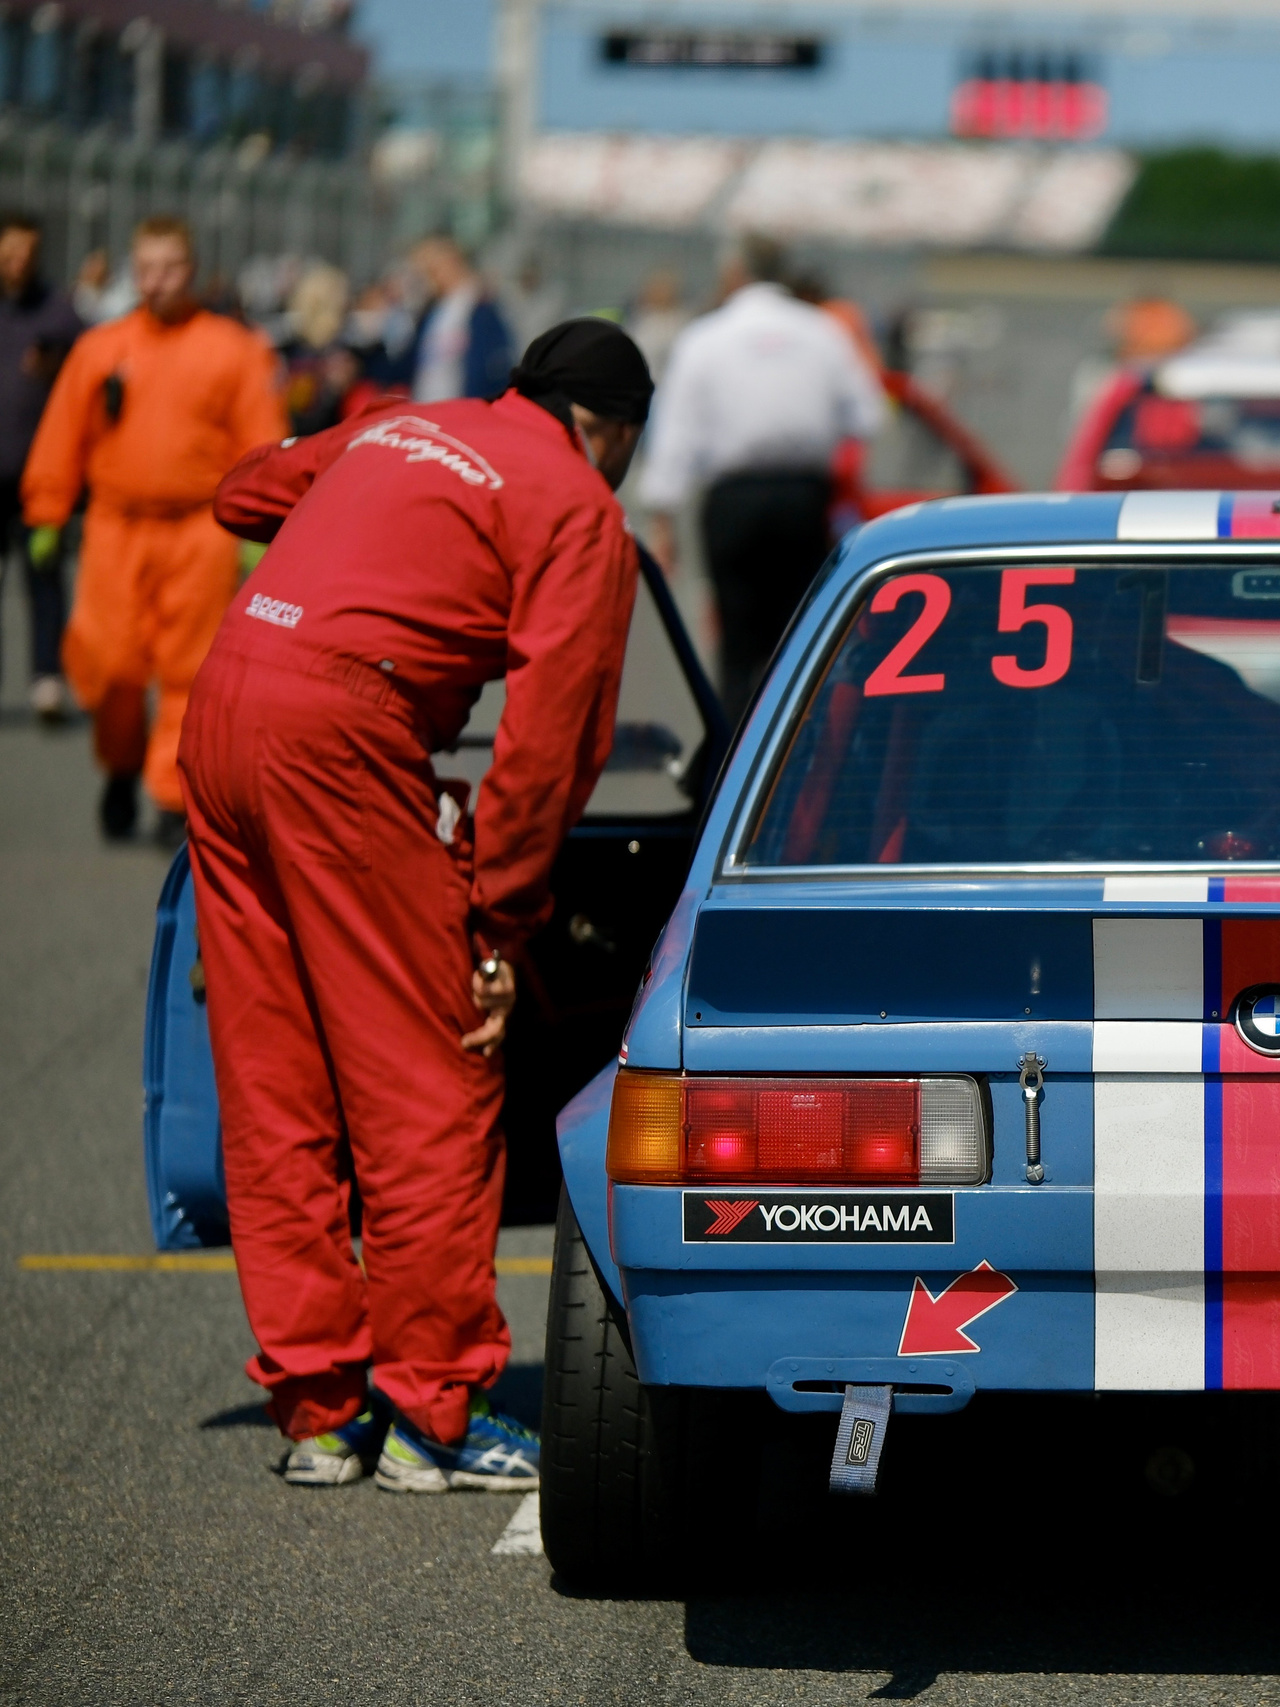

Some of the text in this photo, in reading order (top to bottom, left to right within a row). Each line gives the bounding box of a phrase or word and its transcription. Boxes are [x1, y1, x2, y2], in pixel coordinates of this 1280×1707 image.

[246, 592, 304, 628] sparco
[759, 1205, 933, 1231] YOKOHAMA
[853, 1423, 870, 1460] TRS
